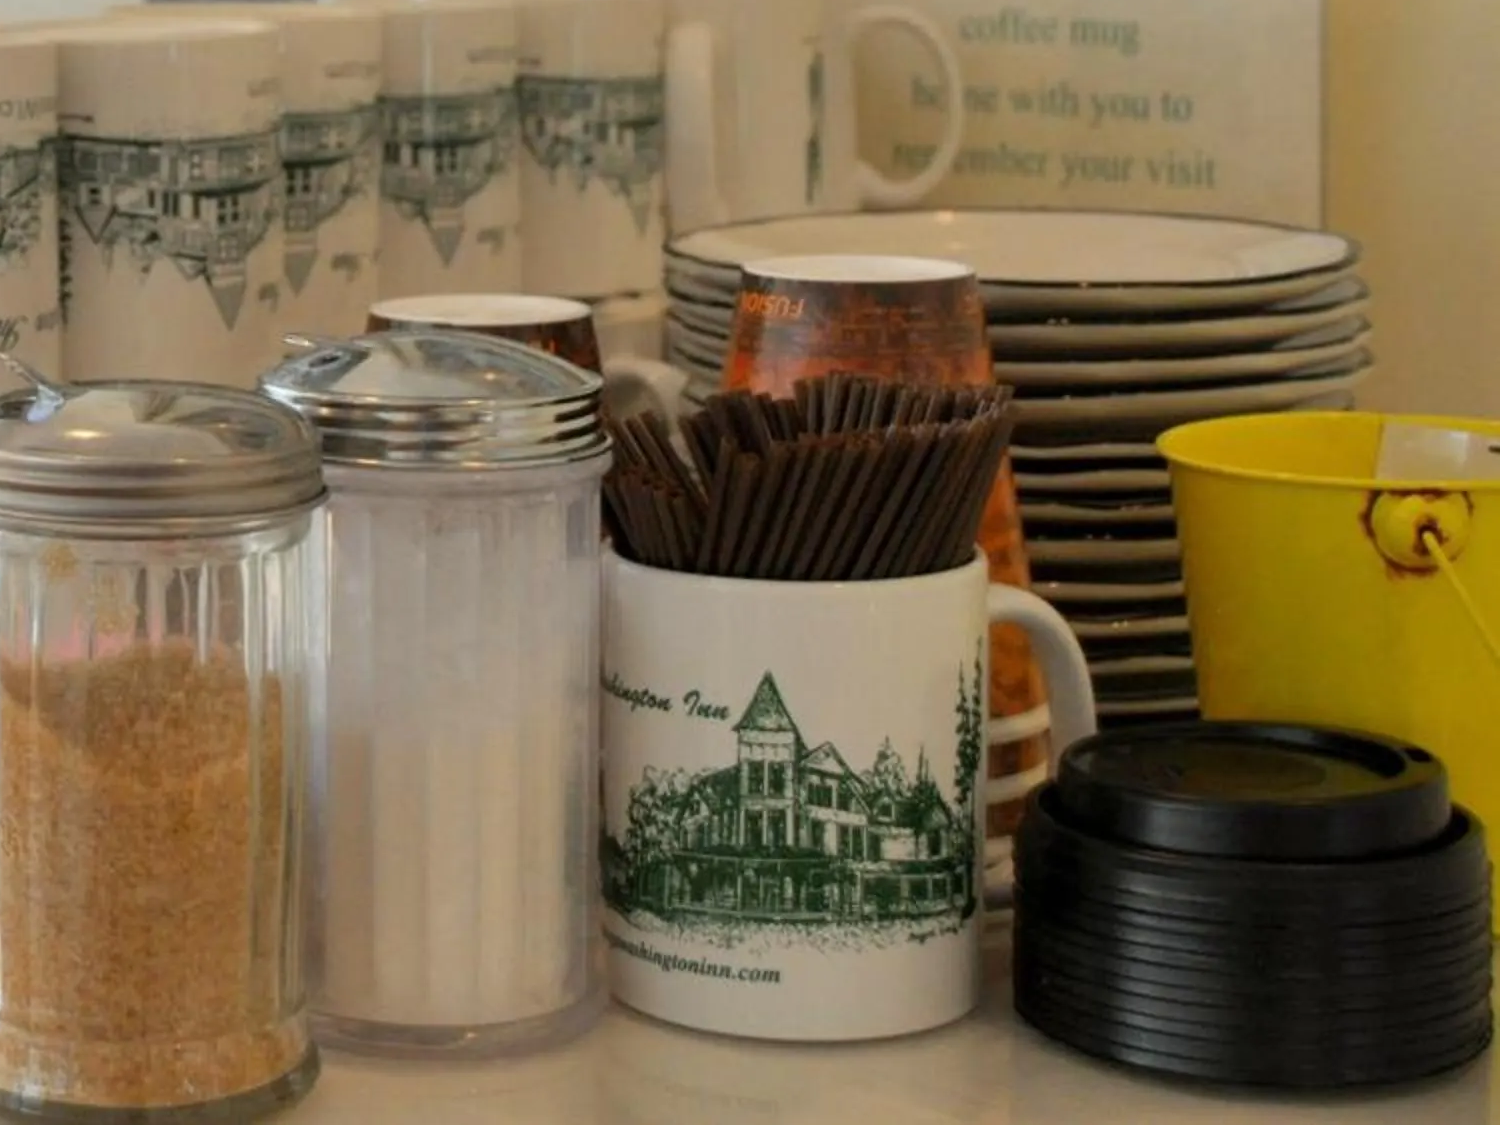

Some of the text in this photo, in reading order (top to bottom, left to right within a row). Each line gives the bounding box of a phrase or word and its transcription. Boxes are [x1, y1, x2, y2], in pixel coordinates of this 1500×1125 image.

[958, 7, 1140, 57] coffee mug
[1007, 81, 1080, 115] with
[1090, 92, 1150, 129] you
[1160, 89, 1193, 122] to
[1058, 151, 1137, 189] your
[1145, 148, 1217, 190] visit
[682, 688, 730, 721] Inn
